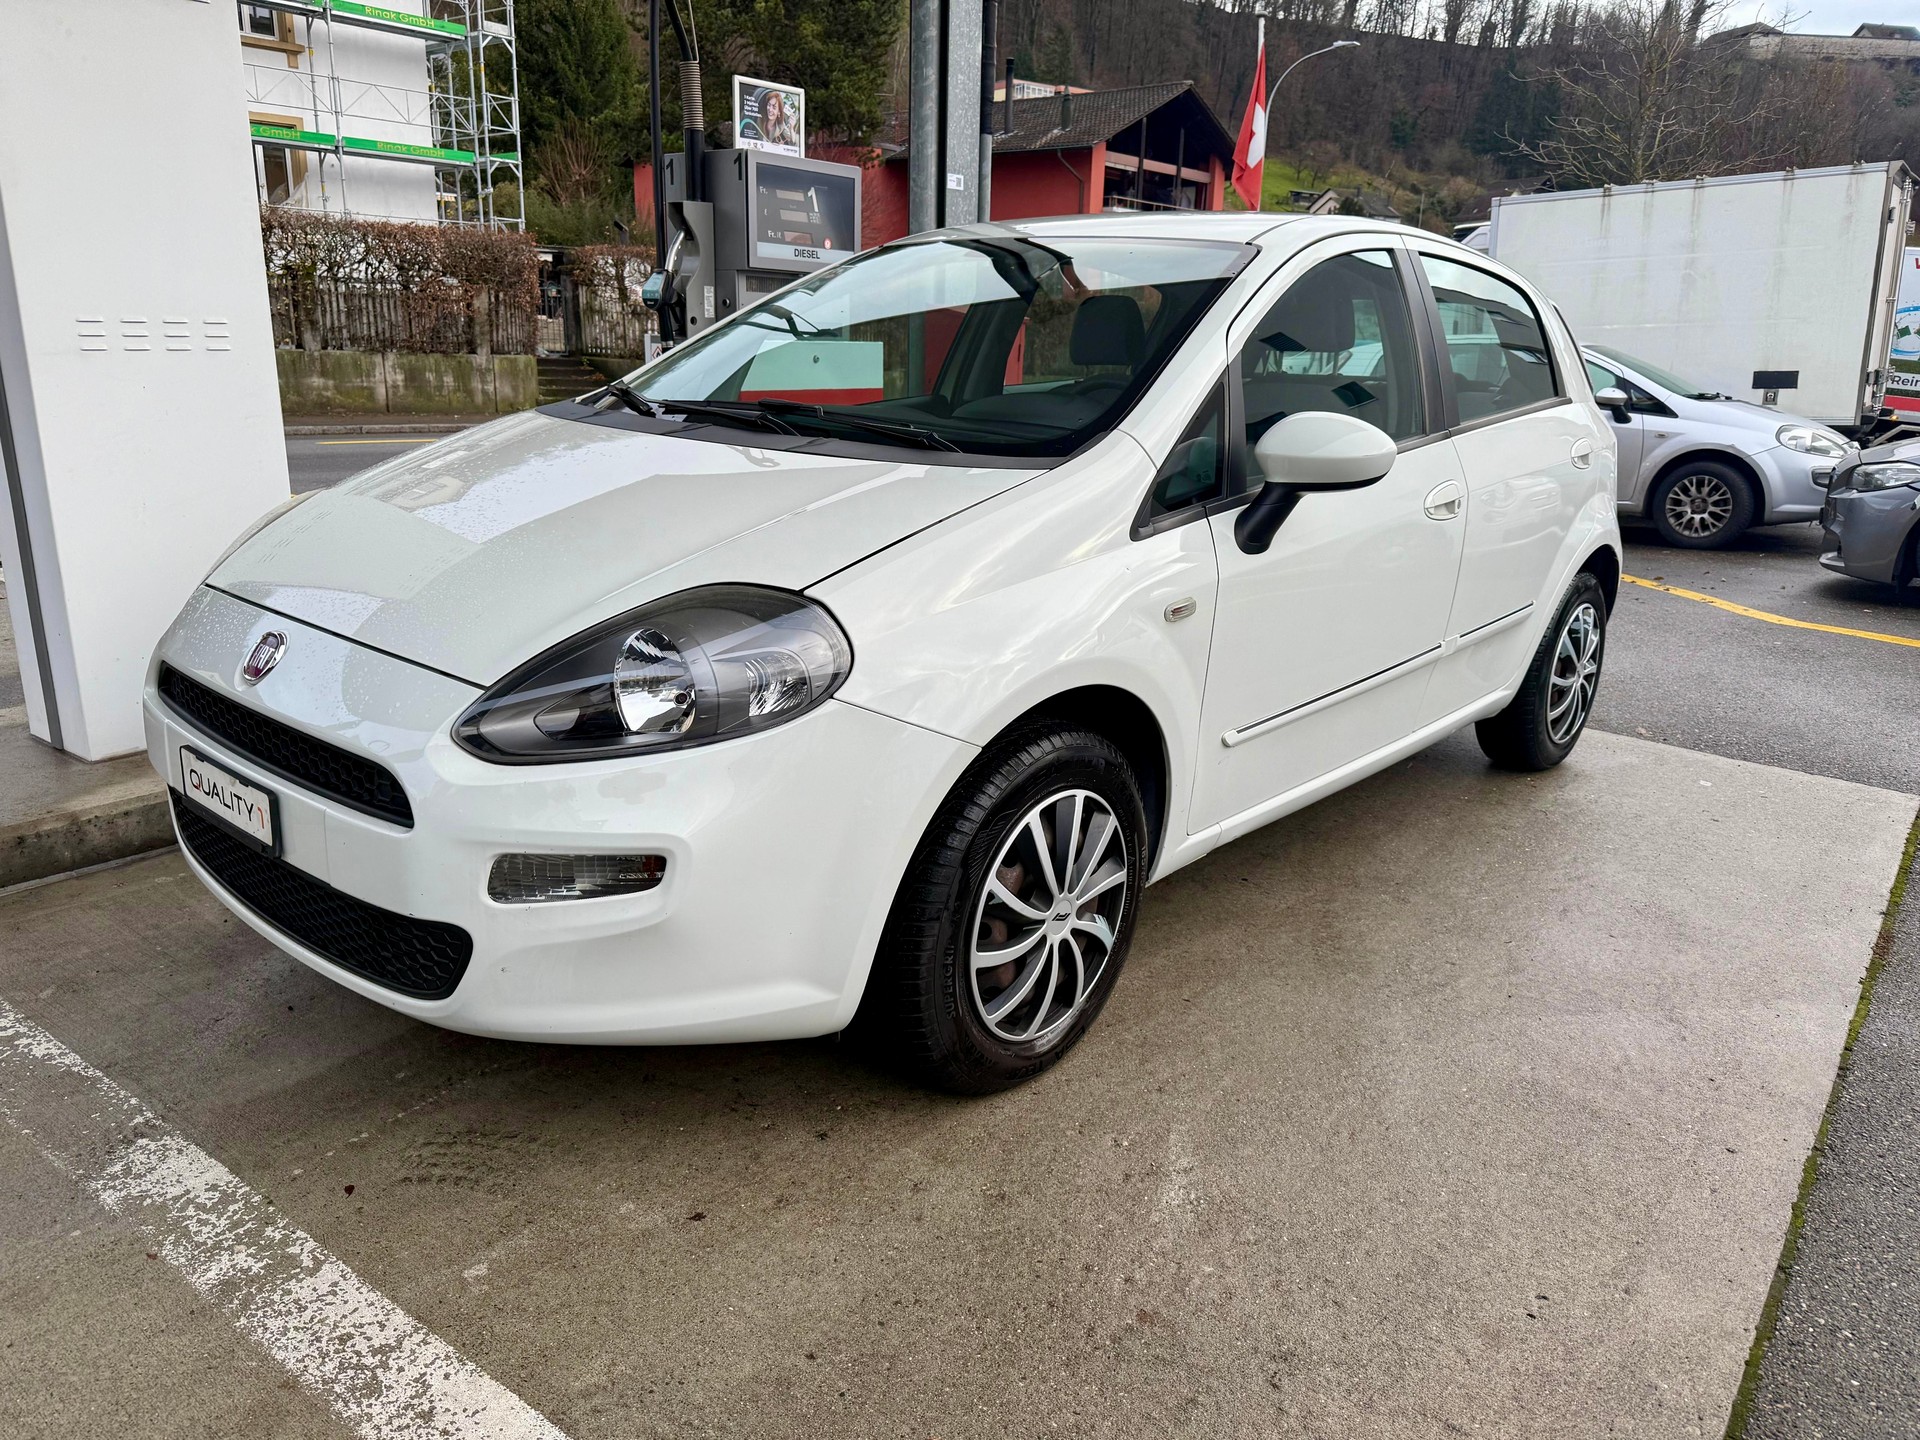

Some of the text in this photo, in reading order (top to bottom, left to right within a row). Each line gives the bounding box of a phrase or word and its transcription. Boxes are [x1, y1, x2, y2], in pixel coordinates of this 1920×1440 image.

[365, 6, 435, 28] Rinak GmbH
[259, 127, 300, 139] GmbH
[377, 142, 445, 158] Rinak GmbH
[666, 158, 674, 185] 1
[734, 152, 743, 181] 1
[807, 186, 819, 213] 1
[793, 248, 821, 260] DIESEL
[249, 643, 276, 670] FIAT
[189, 768, 254, 822] QUALITY
